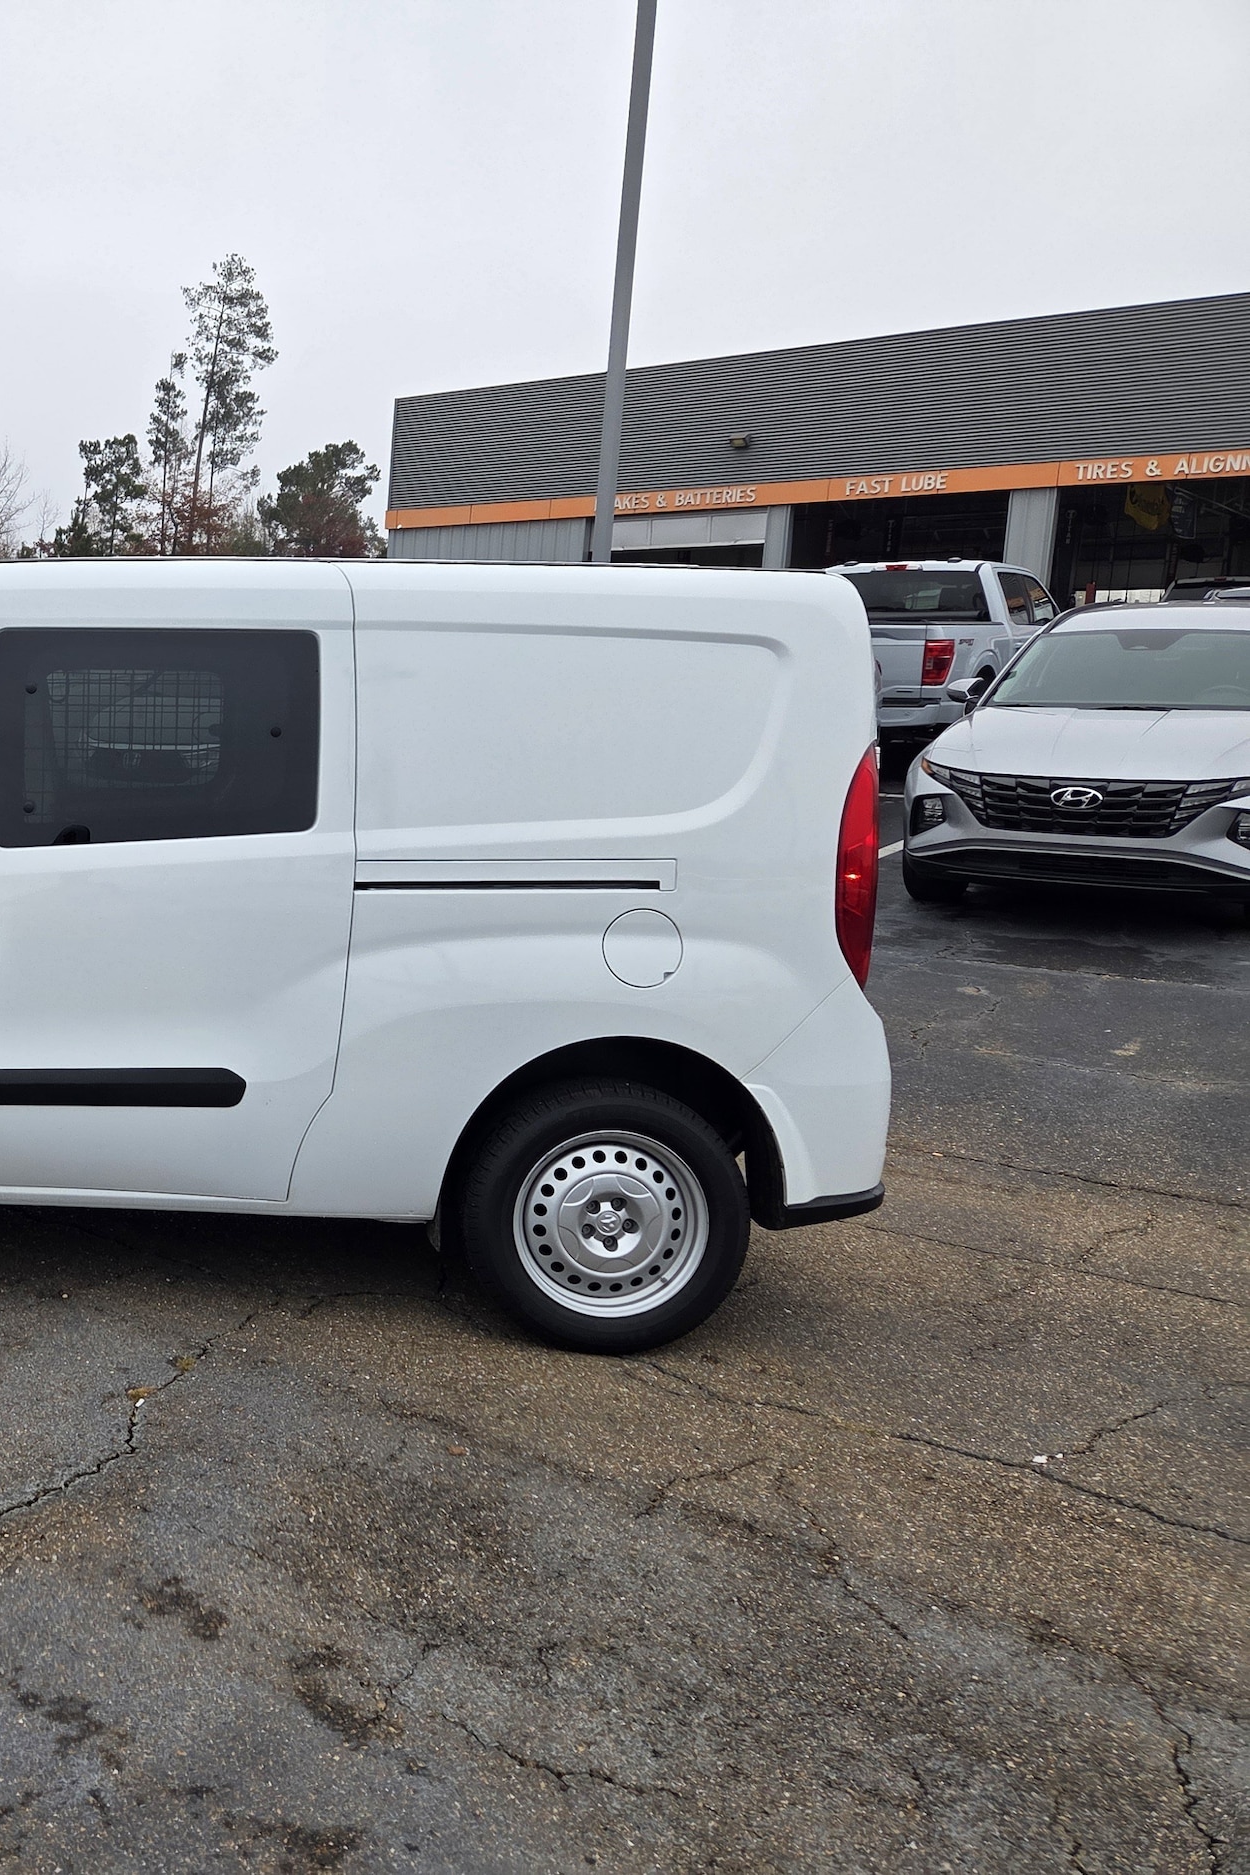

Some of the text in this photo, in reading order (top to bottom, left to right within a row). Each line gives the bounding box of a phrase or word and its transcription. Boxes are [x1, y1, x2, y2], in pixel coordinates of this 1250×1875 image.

[1075, 461, 1133, 481] TIRES
[1145, 459, 1163, 477] &
[845, 473, 949, 496] FAST LUBE
[594, 487, 757, 512] AKES & BATTERIES
